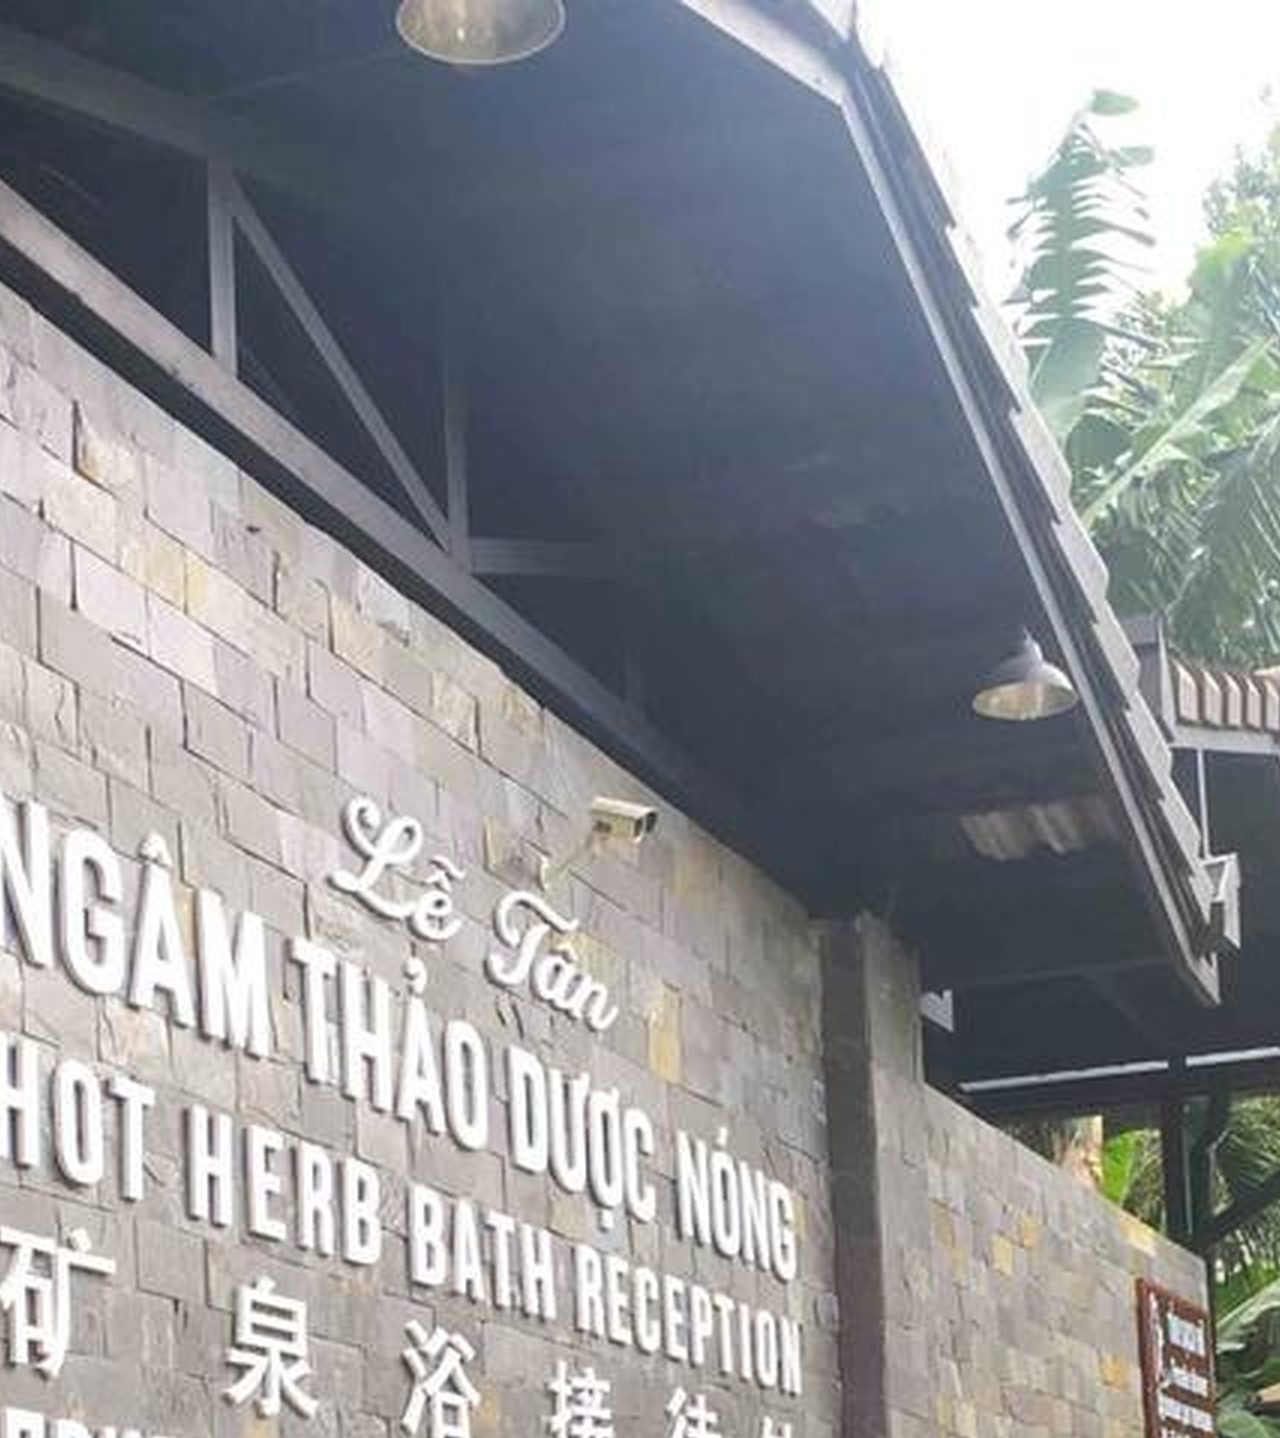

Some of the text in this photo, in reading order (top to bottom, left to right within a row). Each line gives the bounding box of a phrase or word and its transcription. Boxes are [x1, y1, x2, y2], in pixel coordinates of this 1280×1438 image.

[485, 890, 619, 1031] Tân
[186, 1106, 383, 1267] HERB
[410, 1182, 558, 1321] BATH
[575, 1244, 804, 1397] RECEPTION
[290, 935, 490, 1150] THẢO
[508, 1045, 657, 1231] DƯỢC
[677, 1126, 798, 1282] NÓNG
